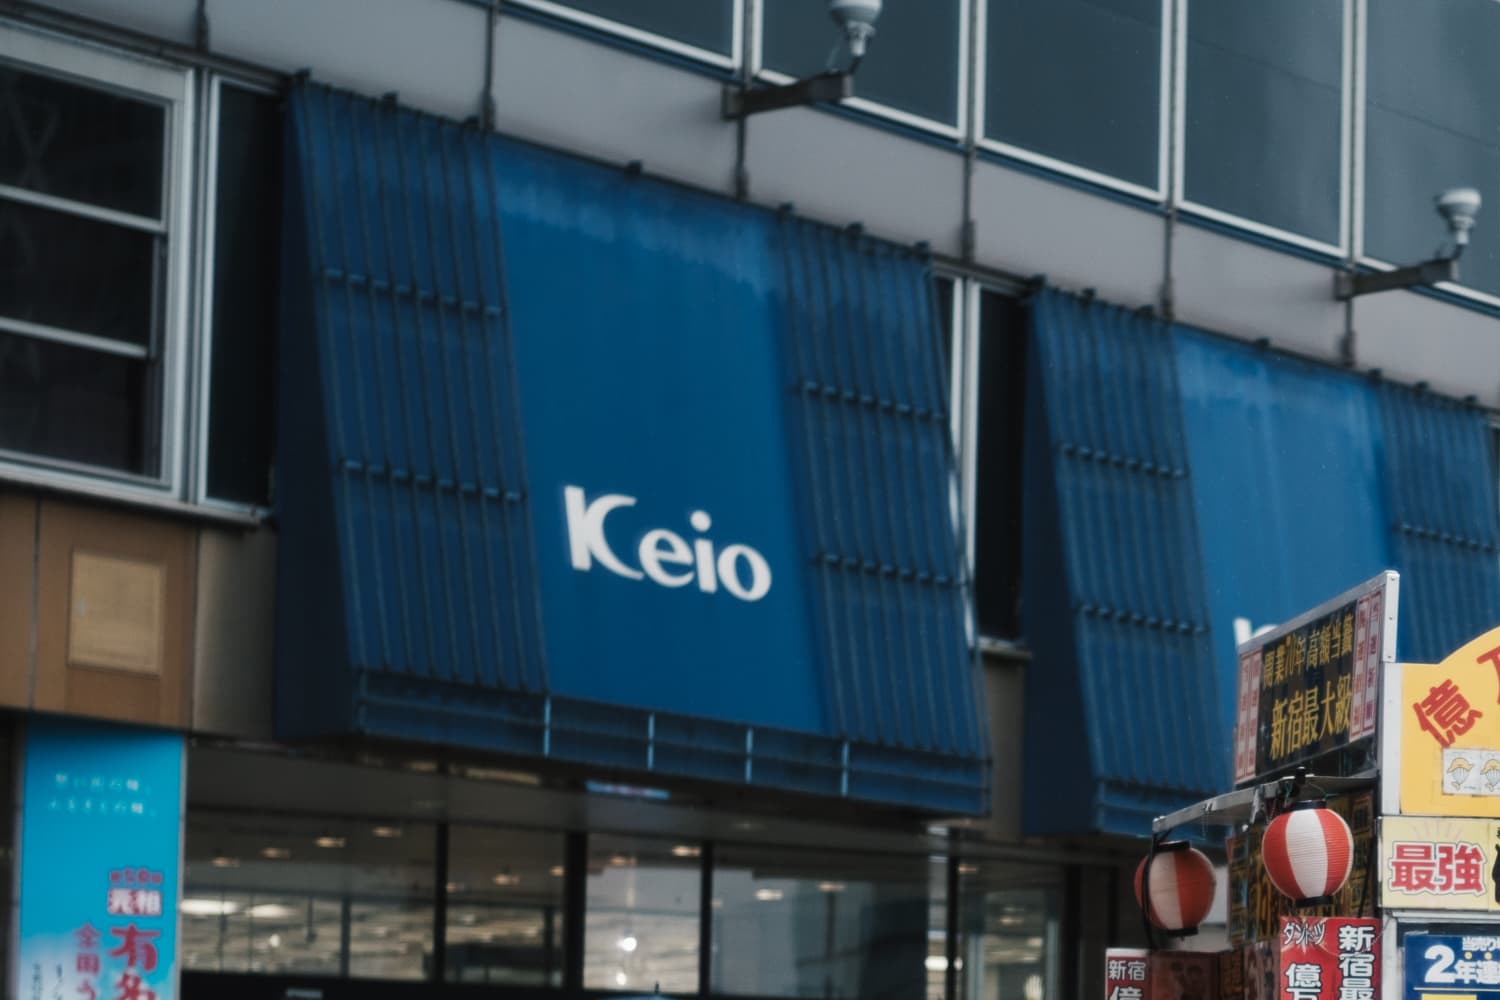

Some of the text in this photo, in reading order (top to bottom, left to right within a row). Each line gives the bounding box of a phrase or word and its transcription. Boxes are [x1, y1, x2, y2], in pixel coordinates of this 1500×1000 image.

[563, 485, 772, 601] Keio
[1389, 841, 1488, 896] 最強
[1283, 922, 1325, 946] ダントツ
[1108, 959, 1146, 982] 新宿
